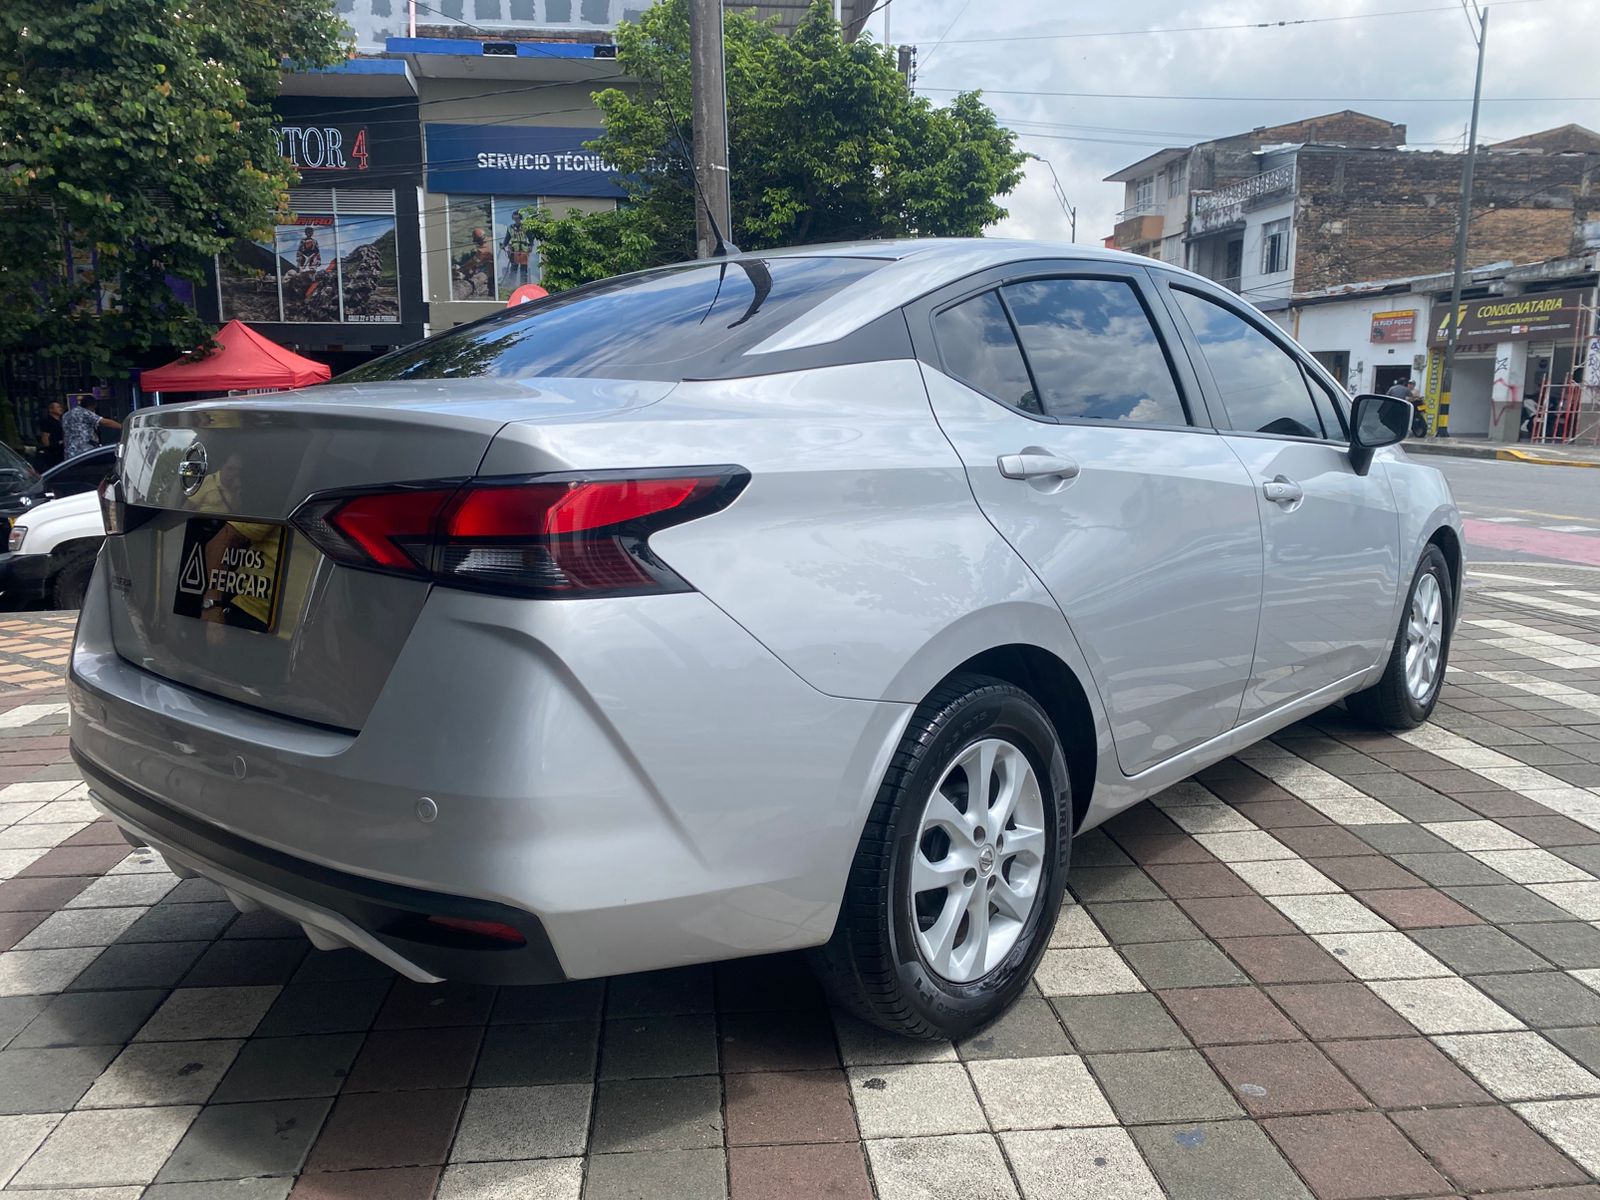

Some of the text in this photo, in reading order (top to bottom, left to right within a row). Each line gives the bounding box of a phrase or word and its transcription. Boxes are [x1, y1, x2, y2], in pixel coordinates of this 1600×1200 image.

[352, 129, 368, 169] 4
[477, 152, 550, 170] SERVICIO
[1477, 298, 1563, 318] CONSIGNATARIA
[221, 546, 263, 569] AUTOS
[208, 568, 268, 599] FERCAR
